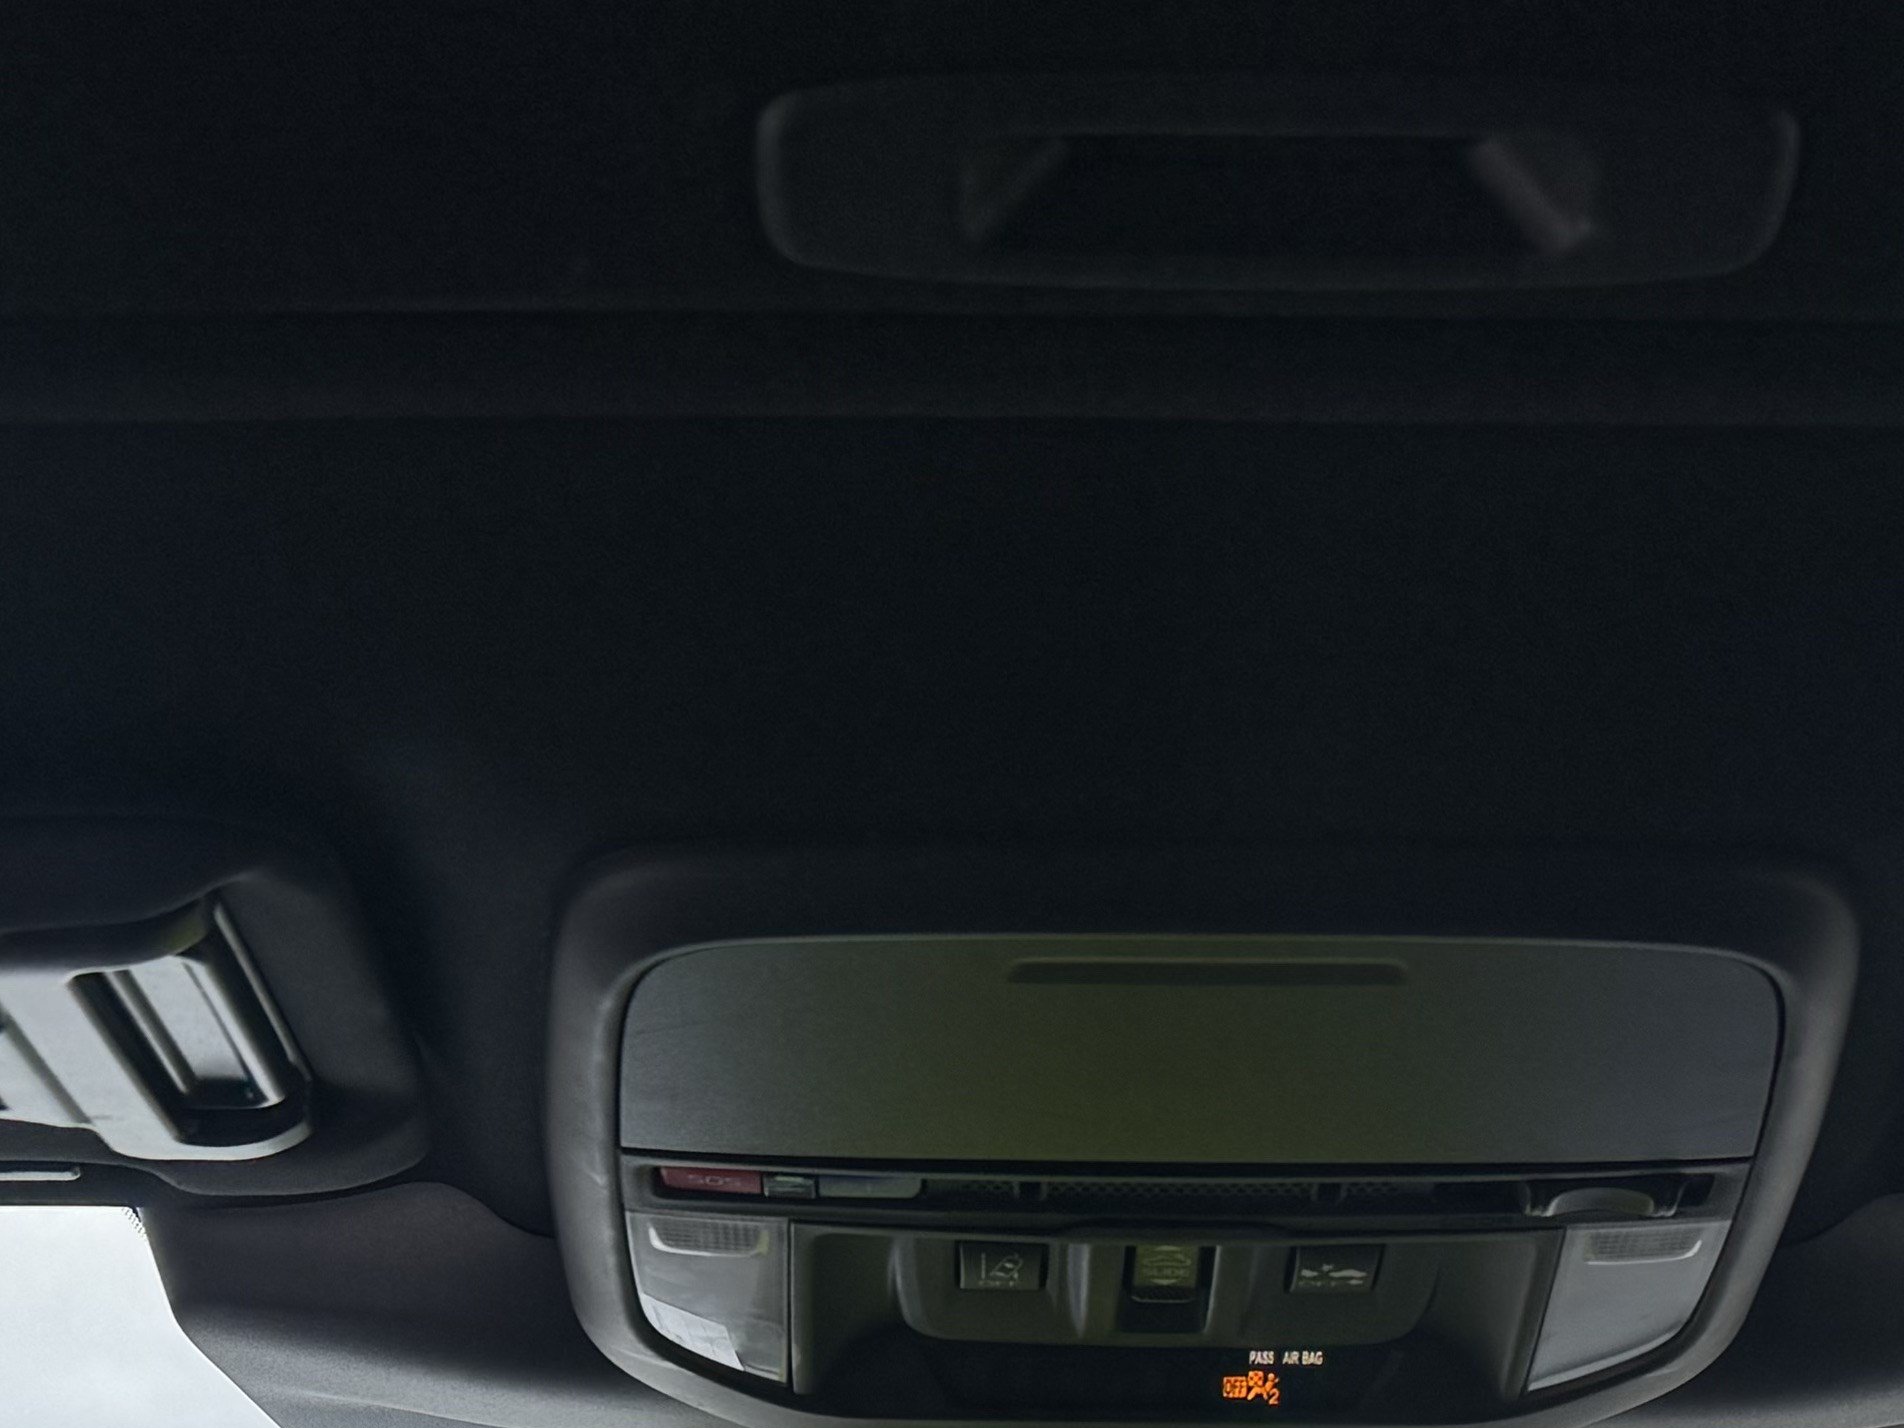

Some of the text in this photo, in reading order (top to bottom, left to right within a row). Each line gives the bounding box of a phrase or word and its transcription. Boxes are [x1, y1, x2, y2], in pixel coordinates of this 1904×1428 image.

[1249, 1351, 1324, 1365] PASS AIR BAG
